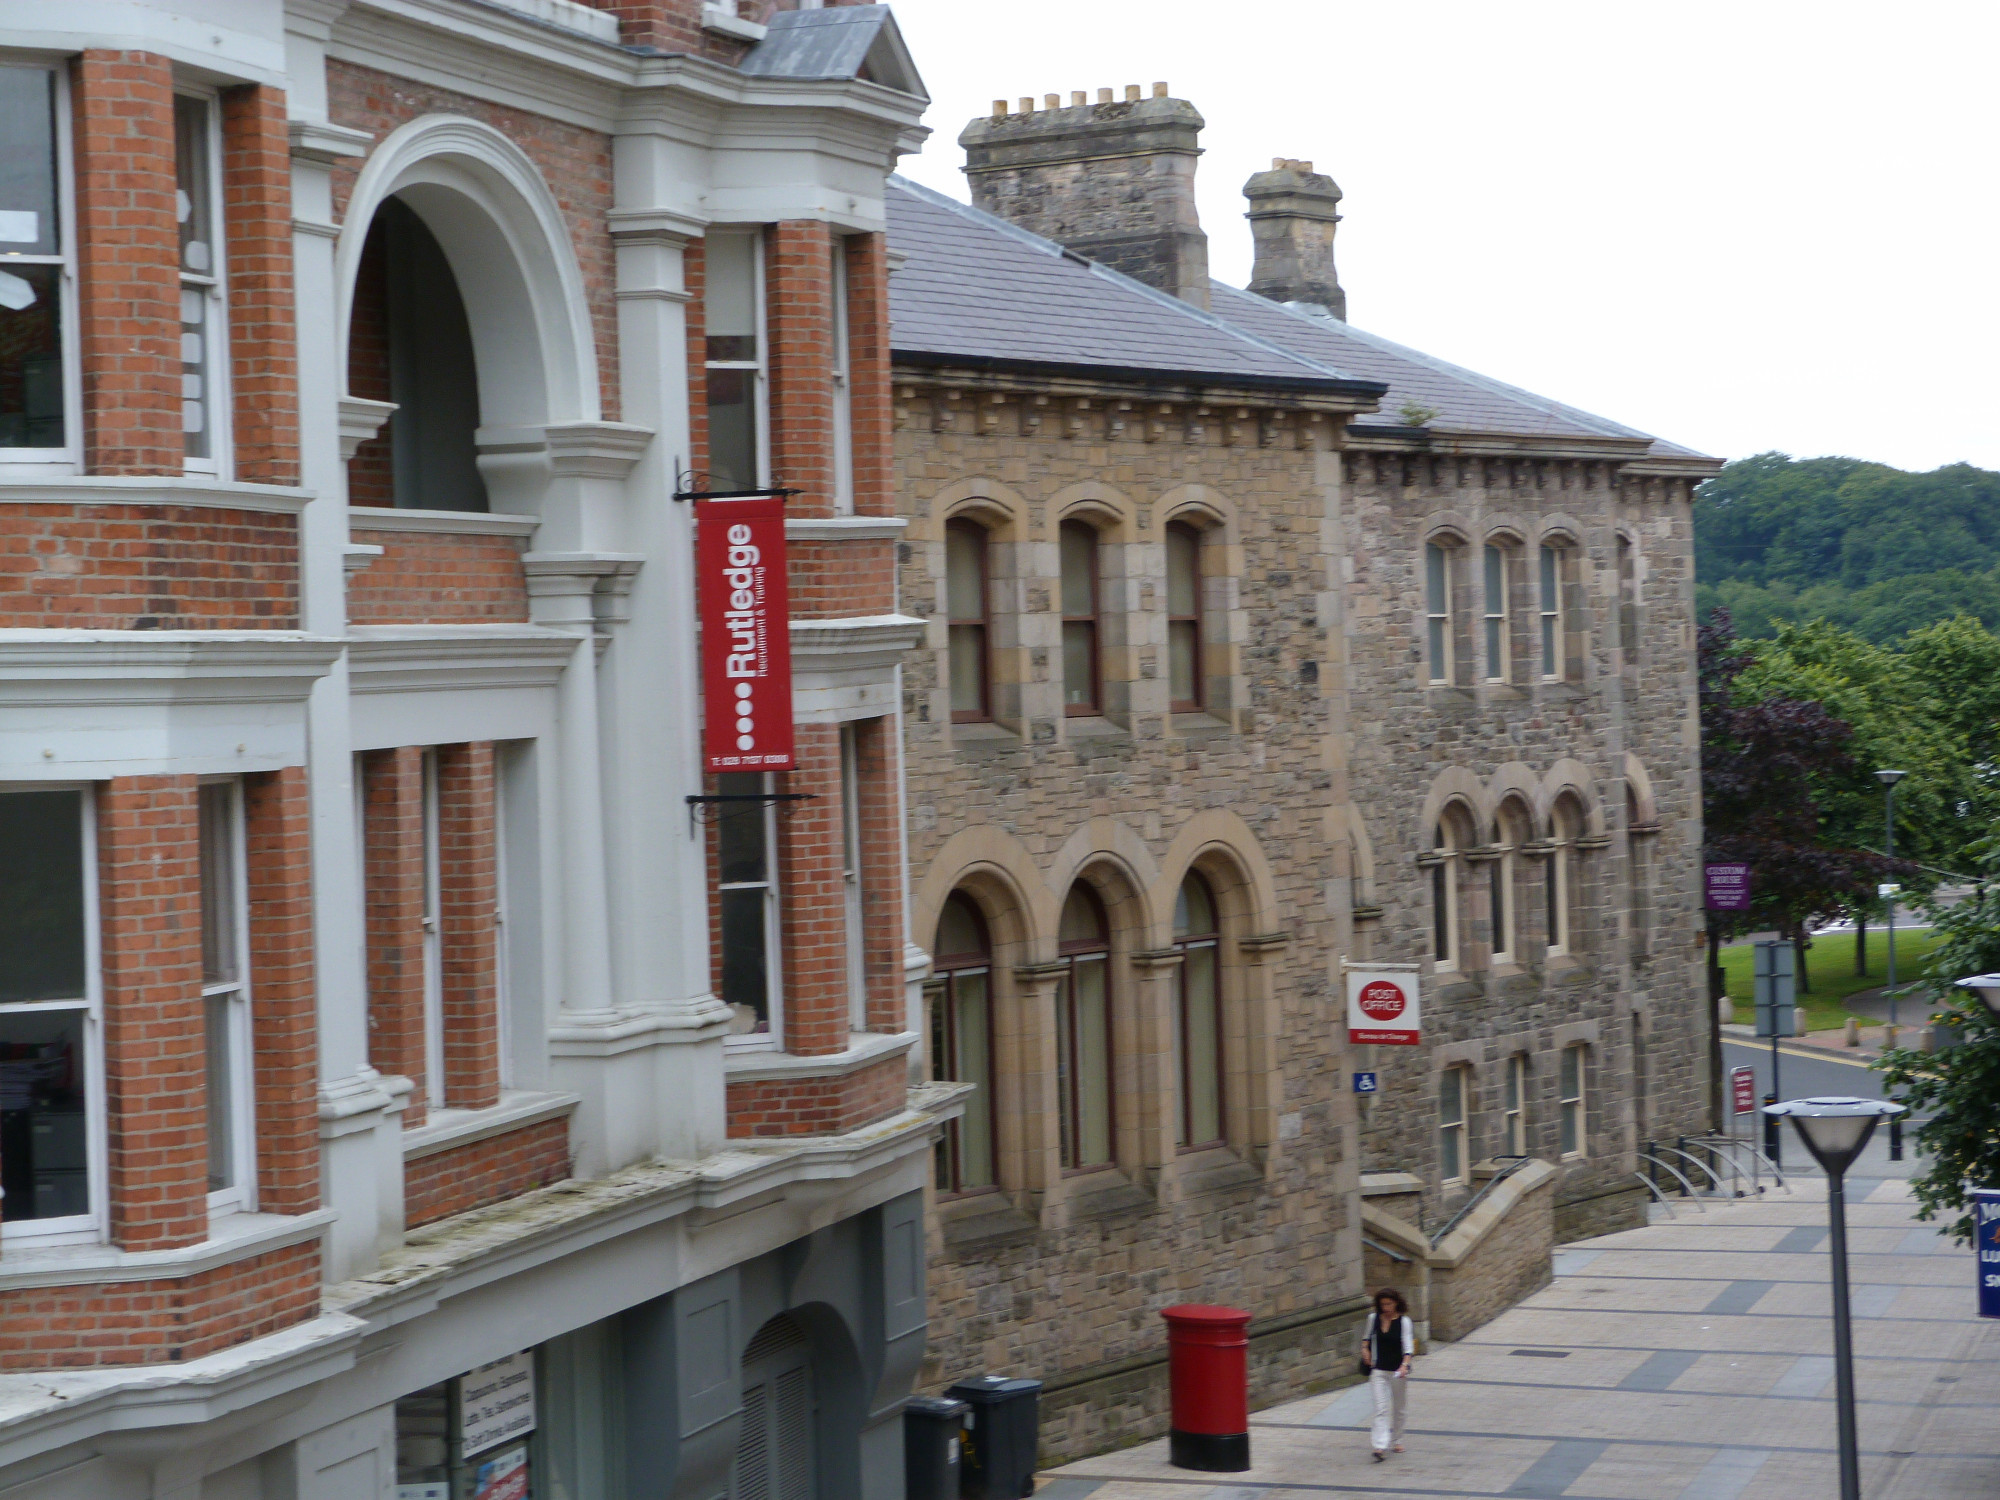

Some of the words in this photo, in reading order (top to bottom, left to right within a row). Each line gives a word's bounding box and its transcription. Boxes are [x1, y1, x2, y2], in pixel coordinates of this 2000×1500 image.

[754, 566, 767, 605] Training
[722, 523, 760, 678] Rutledge
[755, 608, 766, 617] &
[756, 619, 768, 677] Recruitment
[1710, 876, 1742, 884] HOUSE
[1367, 988, 1397, 999] POST
[1361, 1000, 1402, 1011] OFFICE
